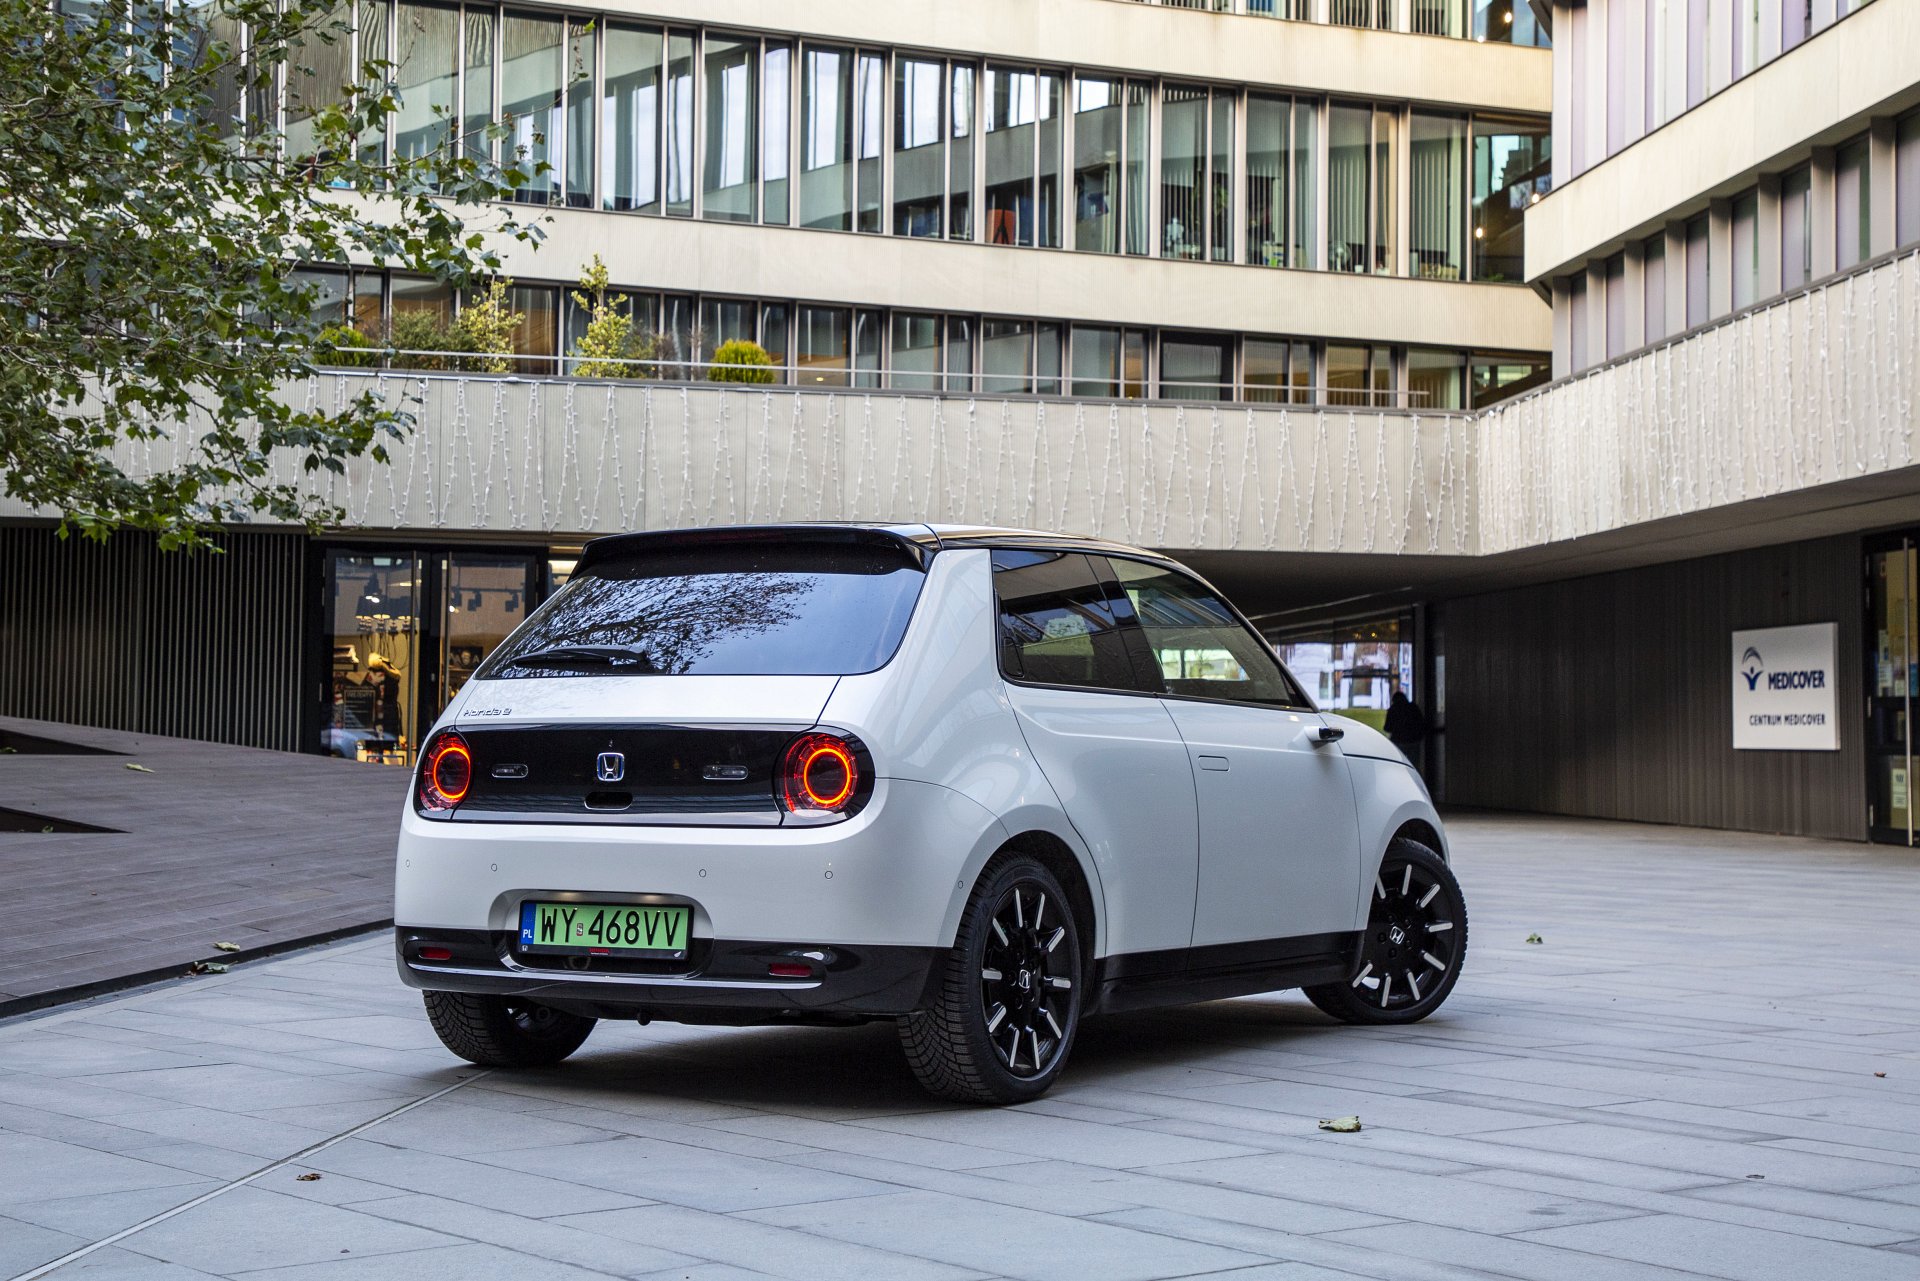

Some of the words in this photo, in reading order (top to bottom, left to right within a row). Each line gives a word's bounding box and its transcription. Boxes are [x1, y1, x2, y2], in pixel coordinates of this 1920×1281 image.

[1768, 670, 1825, 690] MEDICOVER
[463, 708, 501, 717] Honda
[1749, 714, 1782, 726] CENTRUM
[1784, 713, 1826, 726] MEDICOVER
[523, 928, 533, 939] PL
[541, 907, 578, 943] WY
[588, 910, 681, 947] 468VV
